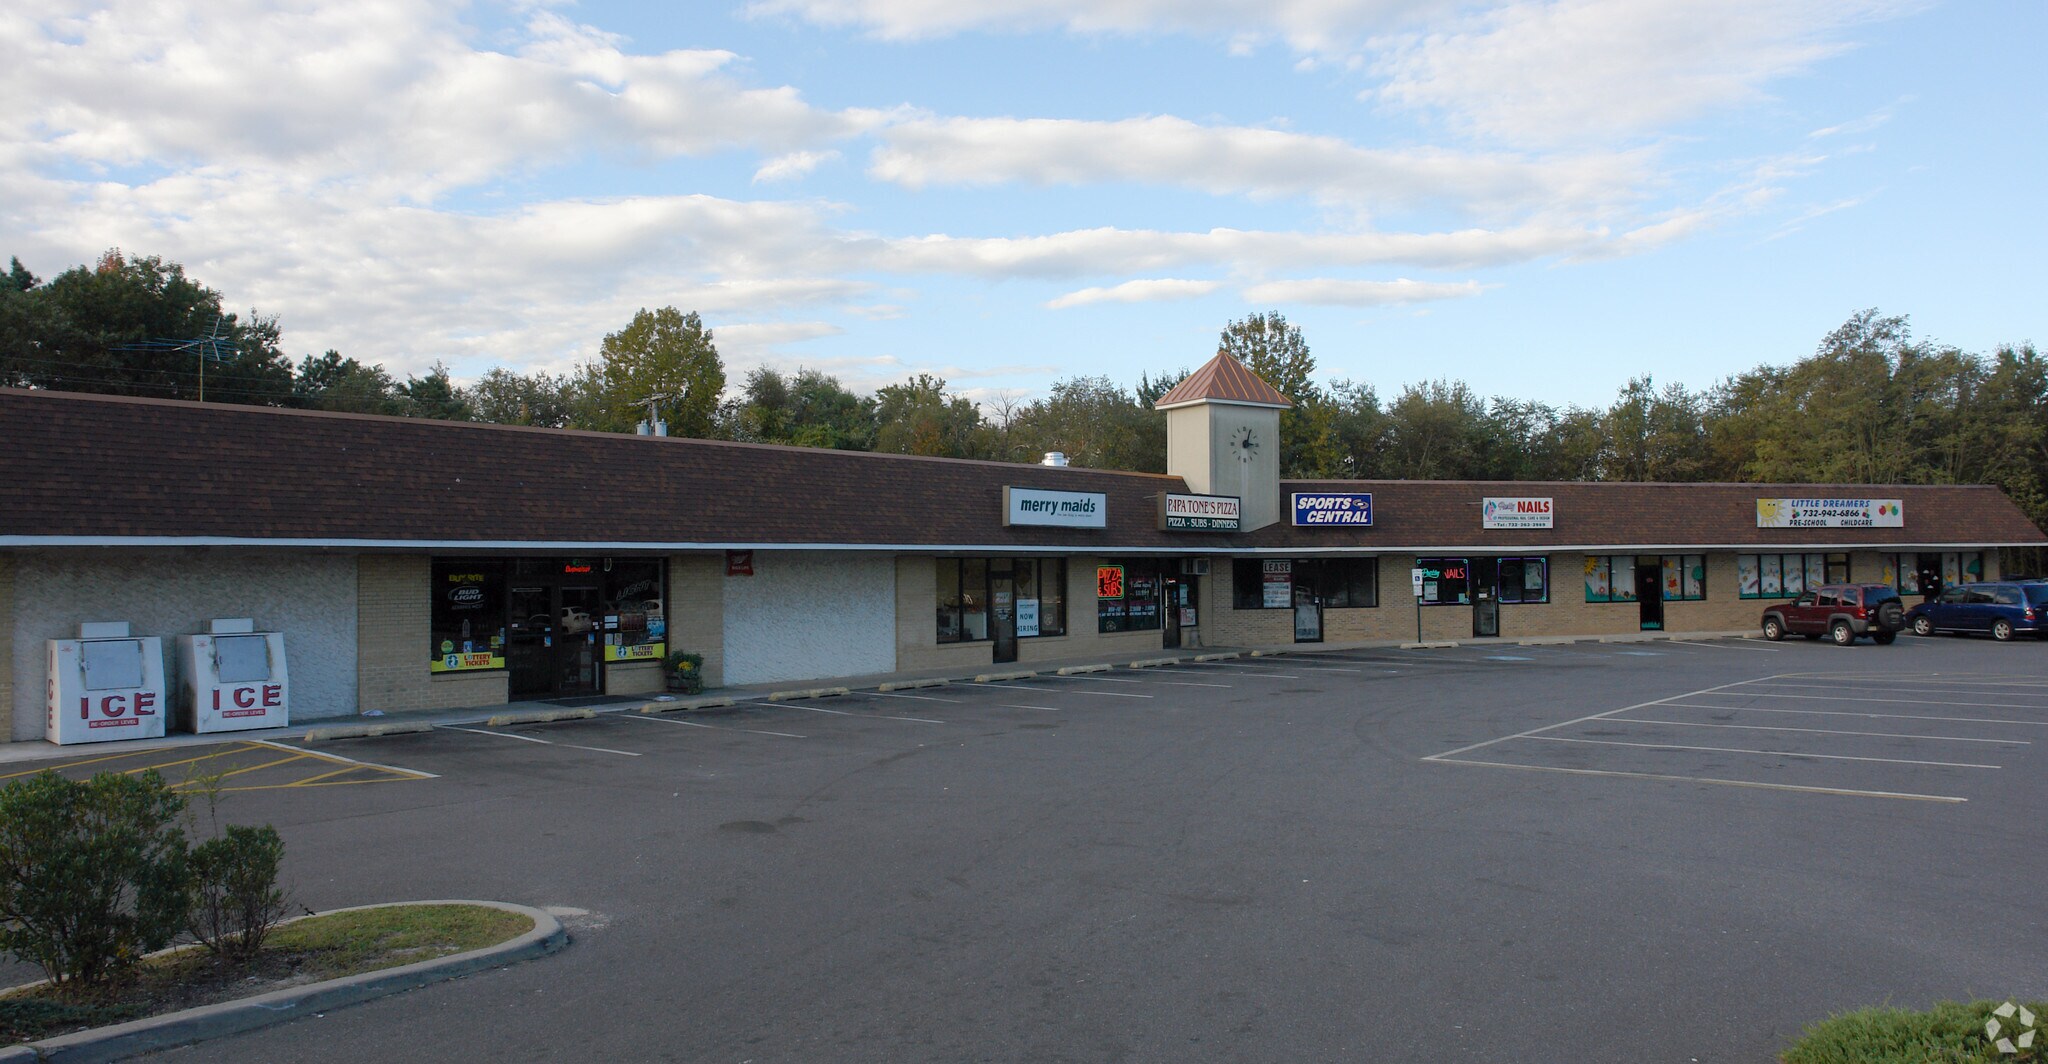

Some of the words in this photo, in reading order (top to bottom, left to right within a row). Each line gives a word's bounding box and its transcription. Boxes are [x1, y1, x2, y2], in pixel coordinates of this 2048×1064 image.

[1020, 499, 1058, 515] merry
[1061, 498, 1096, 513] maids
[1167, 498, 1186, 513] PAPA
[1187, 499, 1216, 514] TONE'S
[1216, 502, 1238, 515] PIZZA
[1297, 497, 1352, 509] SPORTS
[1517, 500, 1550, 513] NAILS
[1791, 499, 1820, 508] LITTLE
[1822, 499, 1871, 508] DREAMERS
[1306, 511, 1368, 523] CENTRAL
[1802, 509, 1860, 517] 732-942-6866
[1167, 518, 1186, 527] PIZZA
[1190, 518, 1208, 528] SUBS
[1211, 519, 1238, 528] DINNERS
[1264, 563, 1289, 572] LEASE
[1443, 567, 1466, 579] NAILS
[1098, 568, 1122, 583] PIZZA
[1103, 581, 1122, 596] SUBS
[464, 653, 491, 661] LOTTERY
[212, 684, 281, 710] ICE
[81, 692, 156, 719] ICE
[223, 710, 250, 718] RE-ORDER
[90, 720, 119, 728] RE-ORDER
[120, 718, 138, 726] LEVEL
